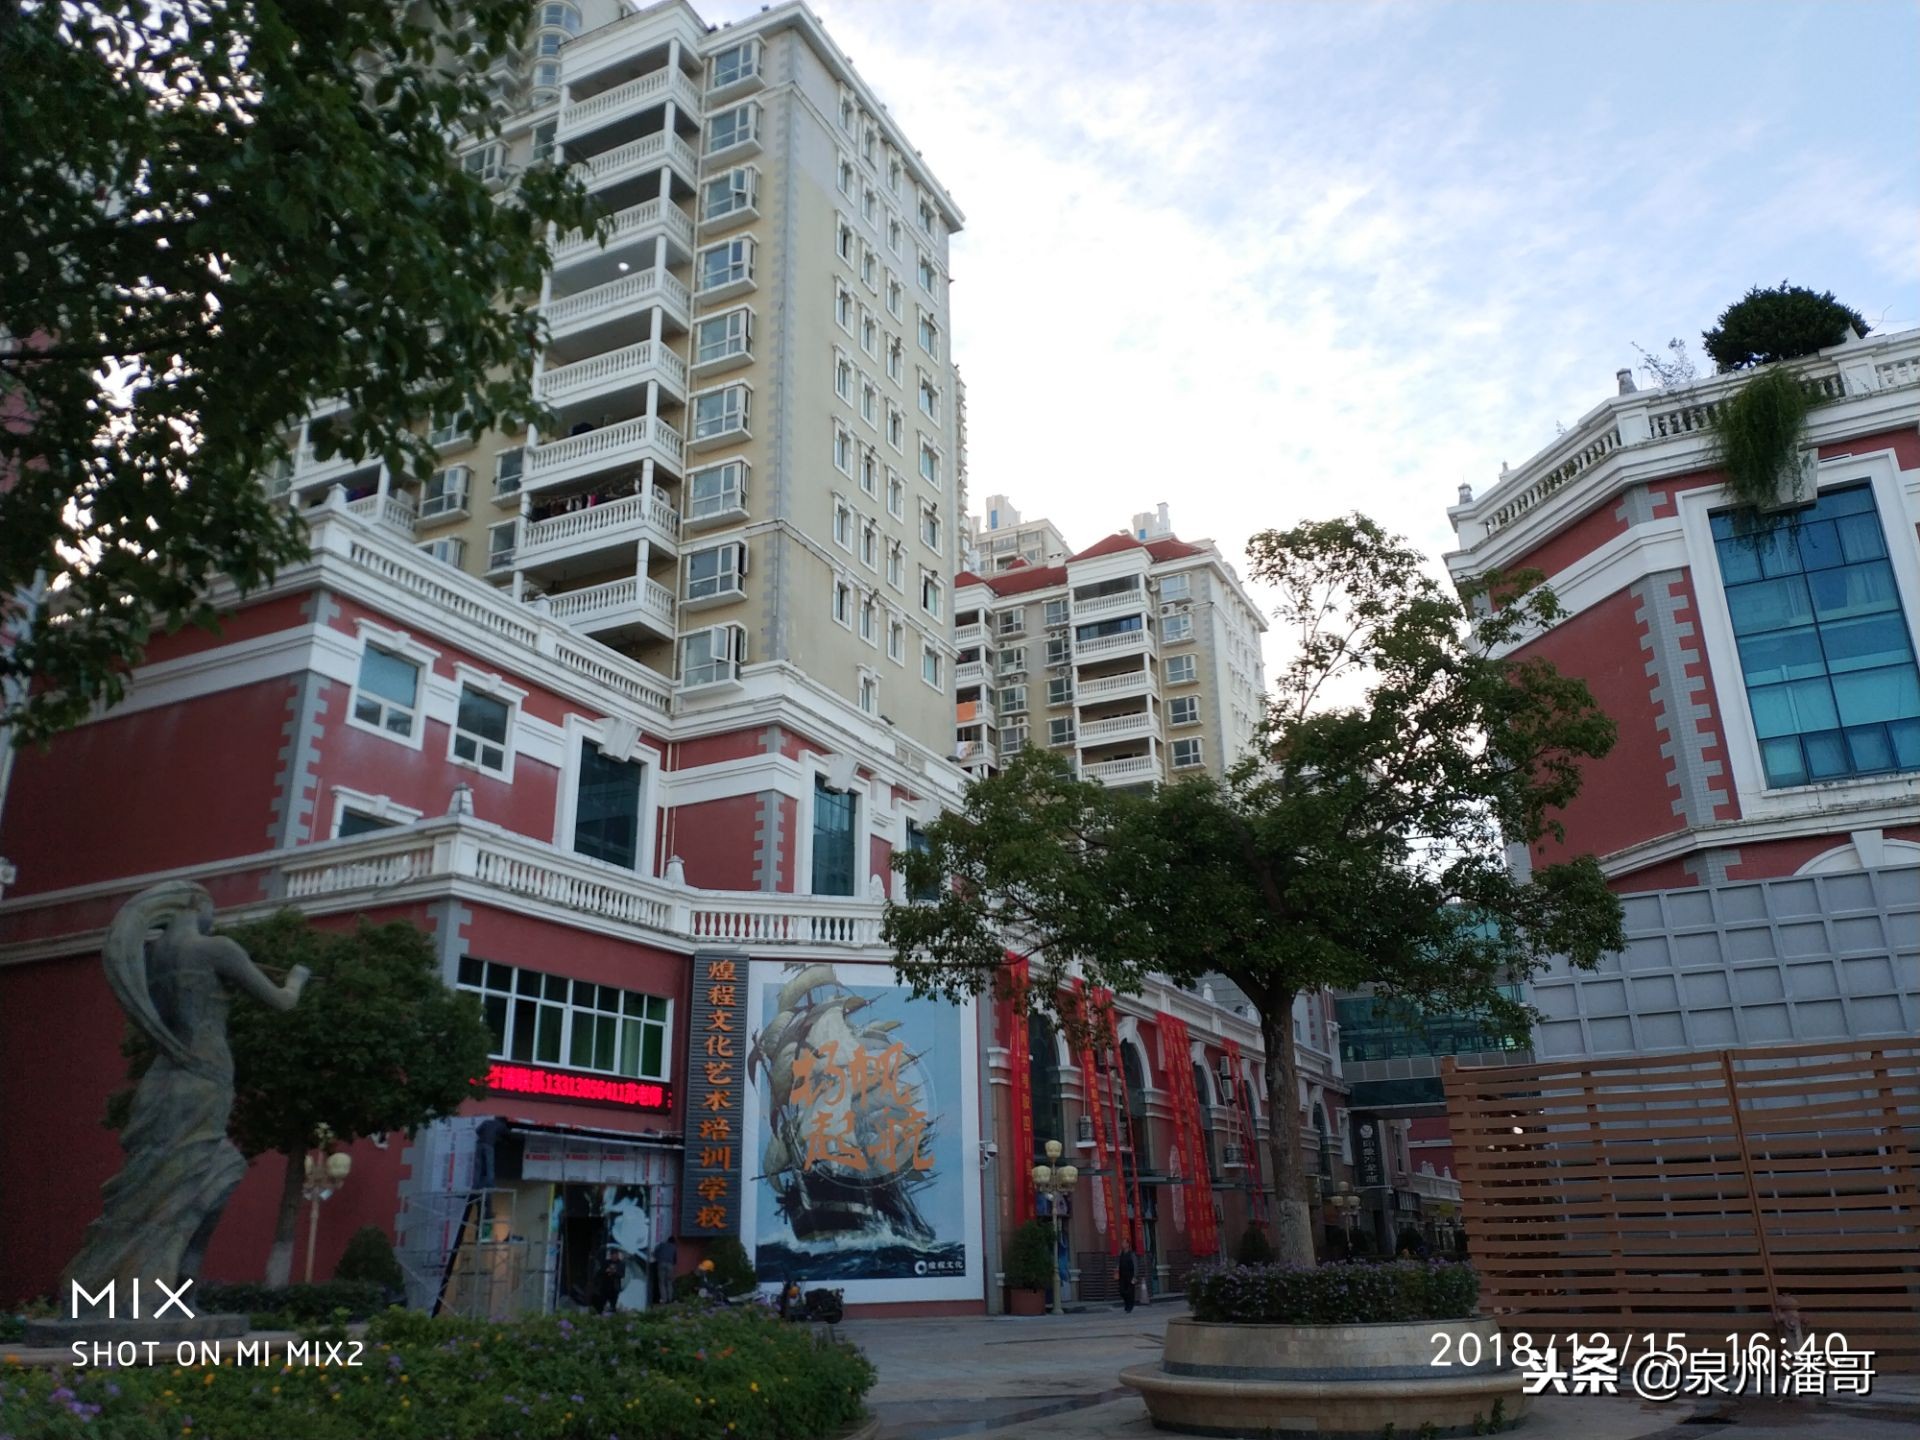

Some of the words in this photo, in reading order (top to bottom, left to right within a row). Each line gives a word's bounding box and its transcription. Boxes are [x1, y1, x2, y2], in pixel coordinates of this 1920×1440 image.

[696, 959, 737, 1229] 煌程文化艺术培训学校
[790, 1039, 912, 1107] 扬帆
[802, 1107, 935, 1172] 起航
